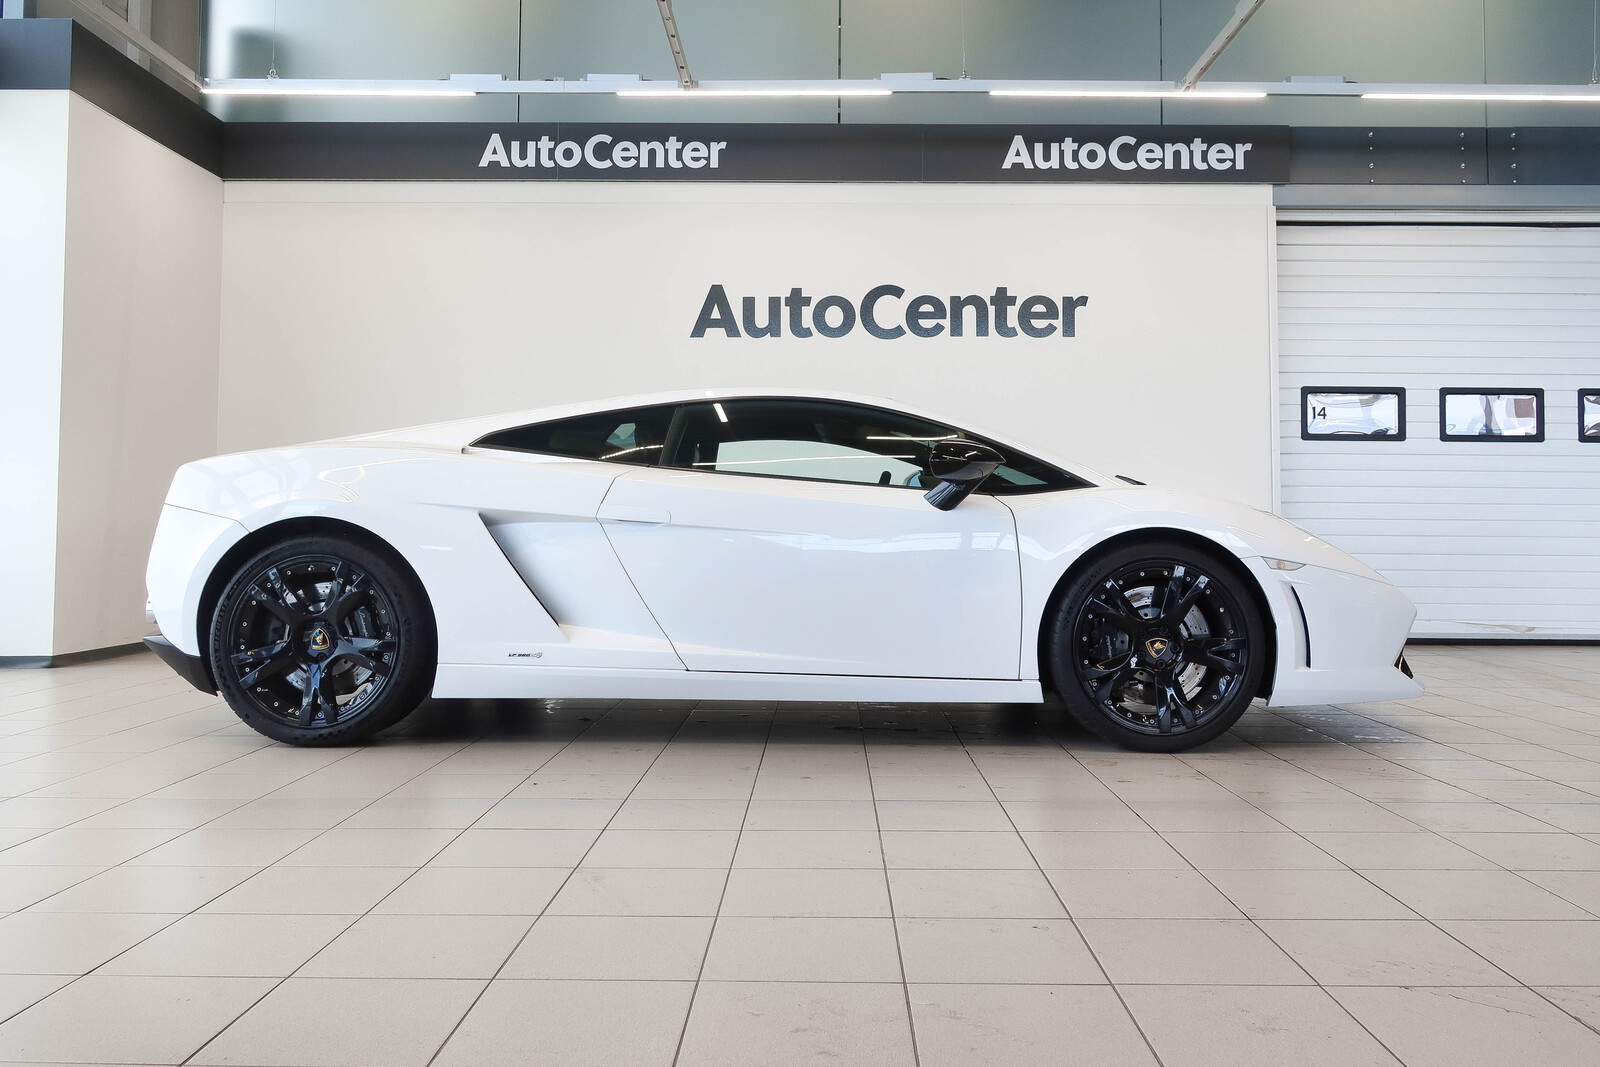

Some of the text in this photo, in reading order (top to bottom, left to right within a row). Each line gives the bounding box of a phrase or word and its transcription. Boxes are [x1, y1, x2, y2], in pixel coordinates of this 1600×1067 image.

[479, 133, 727, 169] AutoCenter
[1002, 135, 1252, 171] AutoCenter
[690, 284, 1088, 340] AutoCenter
[1312, 406, 1327, 420] 14
